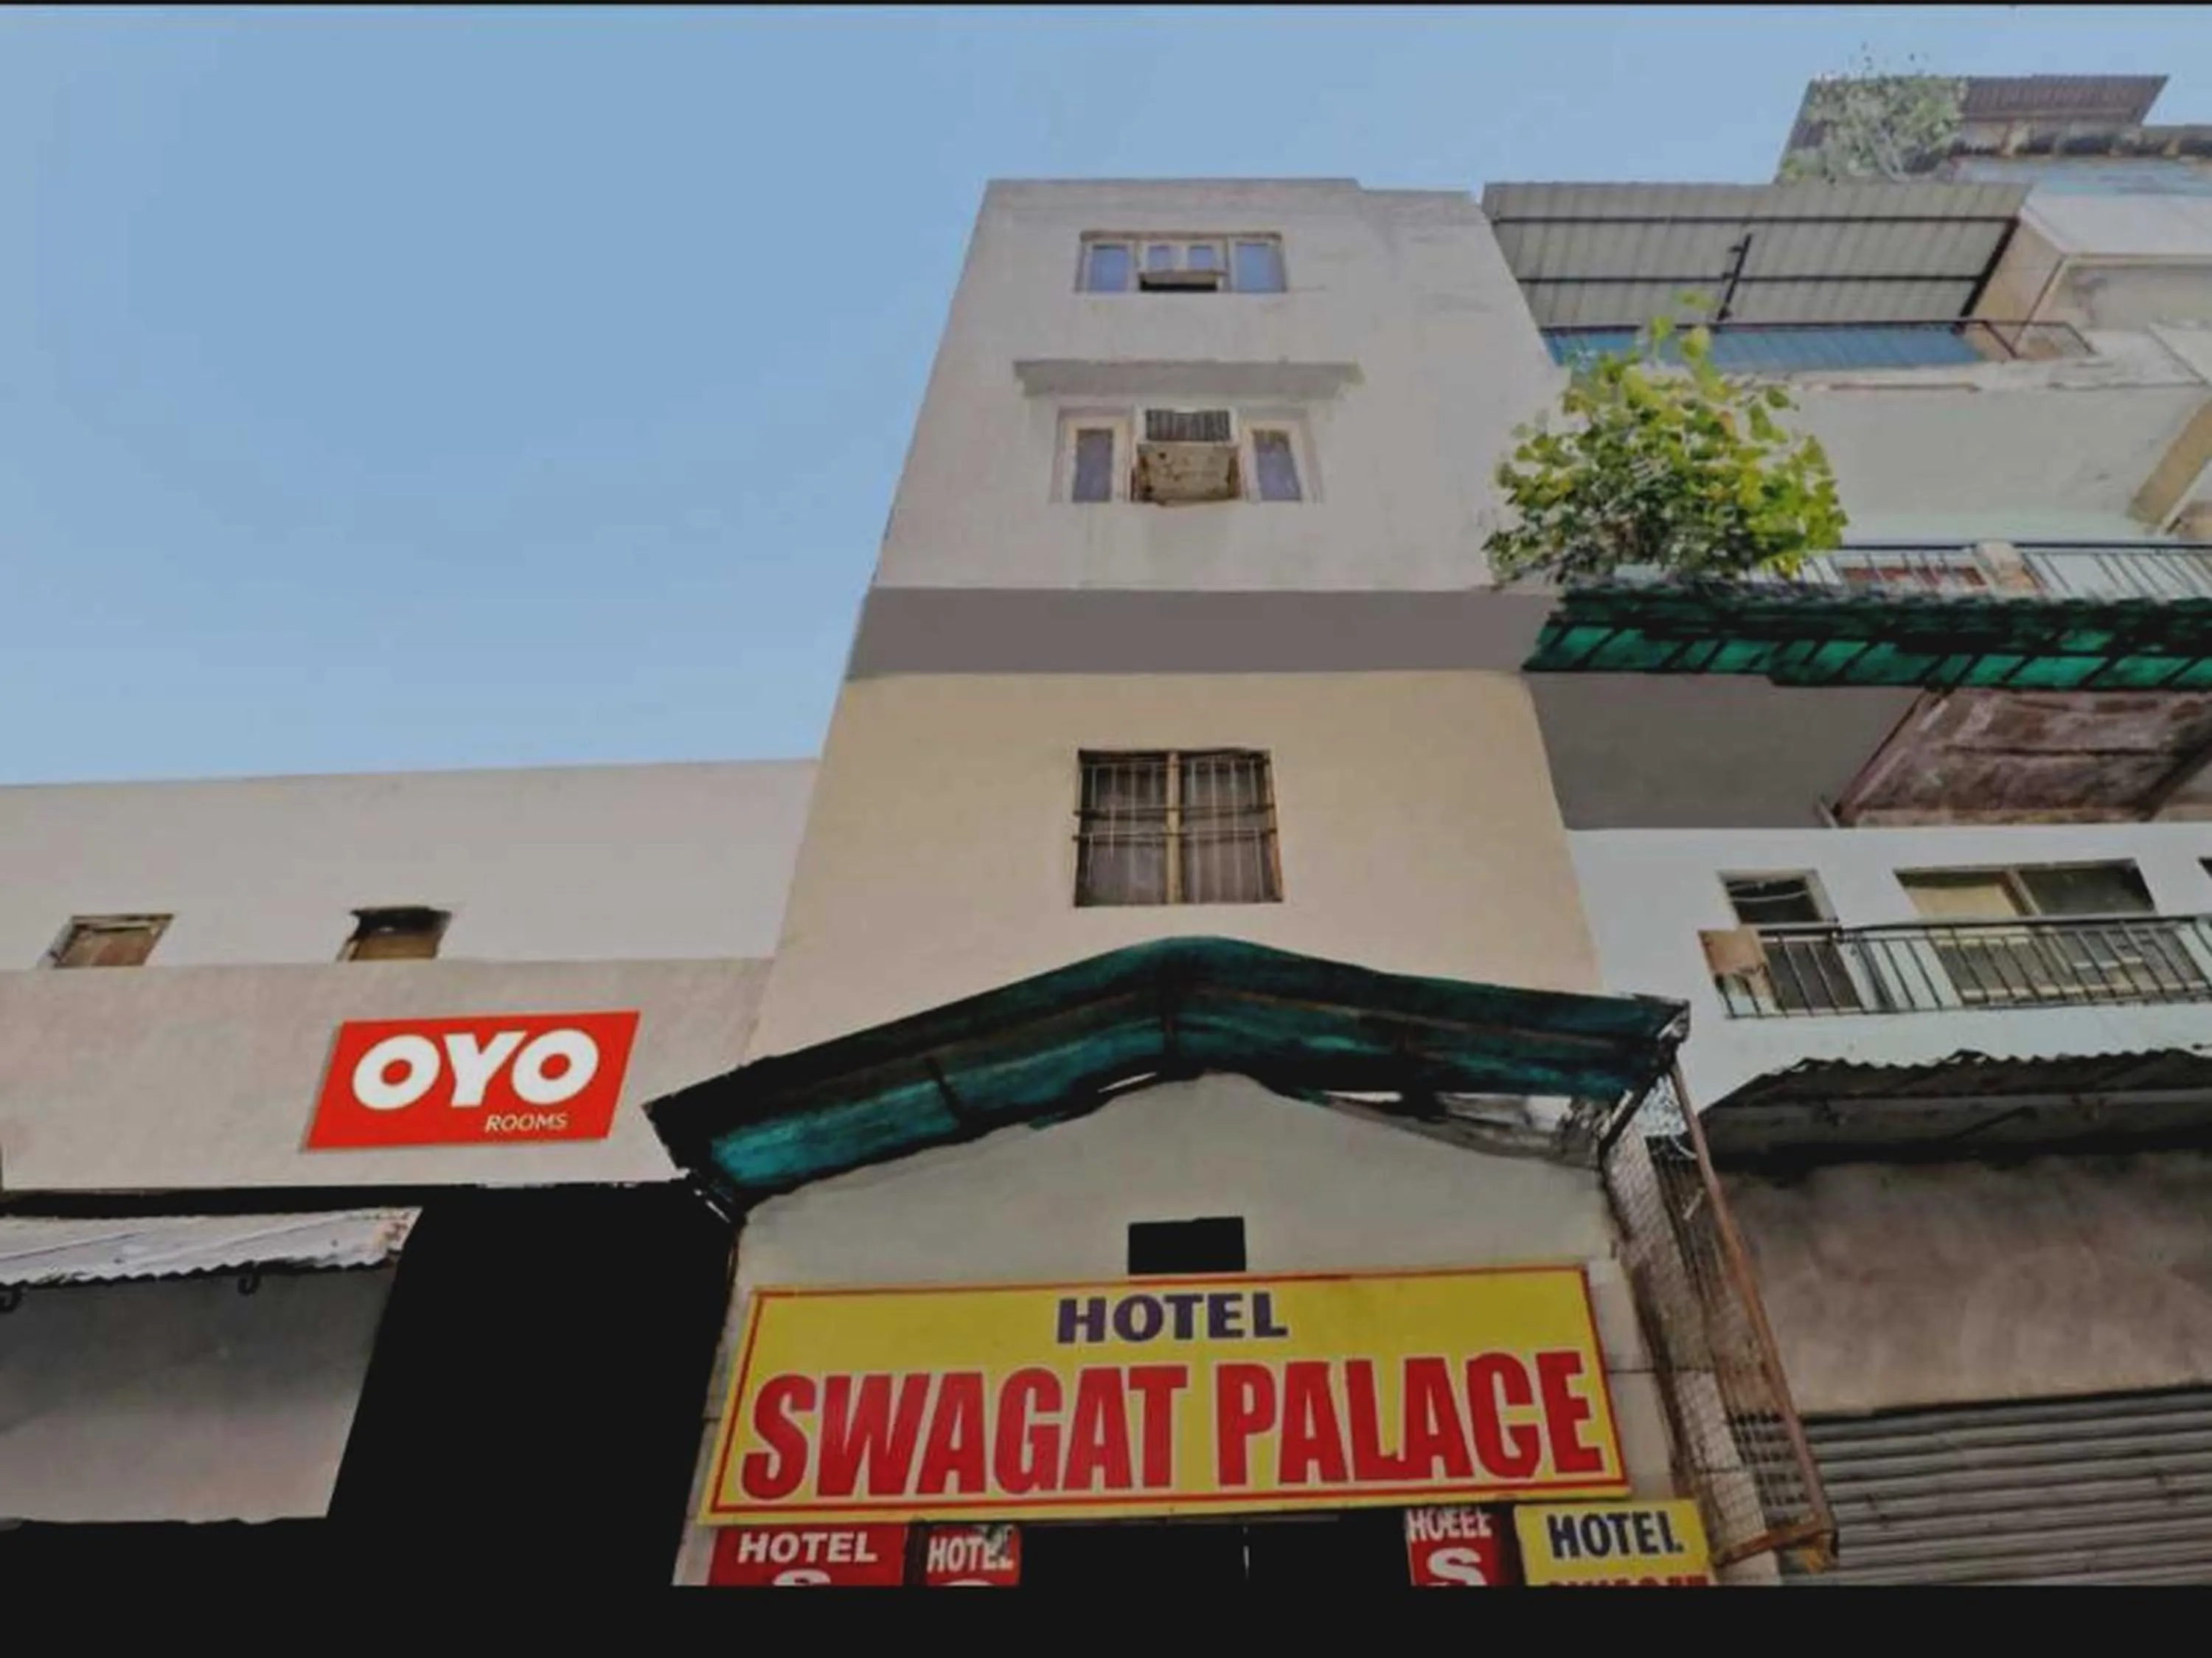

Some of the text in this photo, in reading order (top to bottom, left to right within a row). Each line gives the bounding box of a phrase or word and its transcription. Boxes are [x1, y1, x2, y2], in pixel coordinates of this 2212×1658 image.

[352, 1028, 599, 1111] OYO
[484, 1112, 568, 1133] ROOMS
[1057, 1292, 1288, 1344] HOTEL
[742, 1350, 1604, 1500] SWAGAT PALACE
[737, 1531, 878, 1564] HOTEL
[1546, 1510, 1684, 1558] HOTEL
